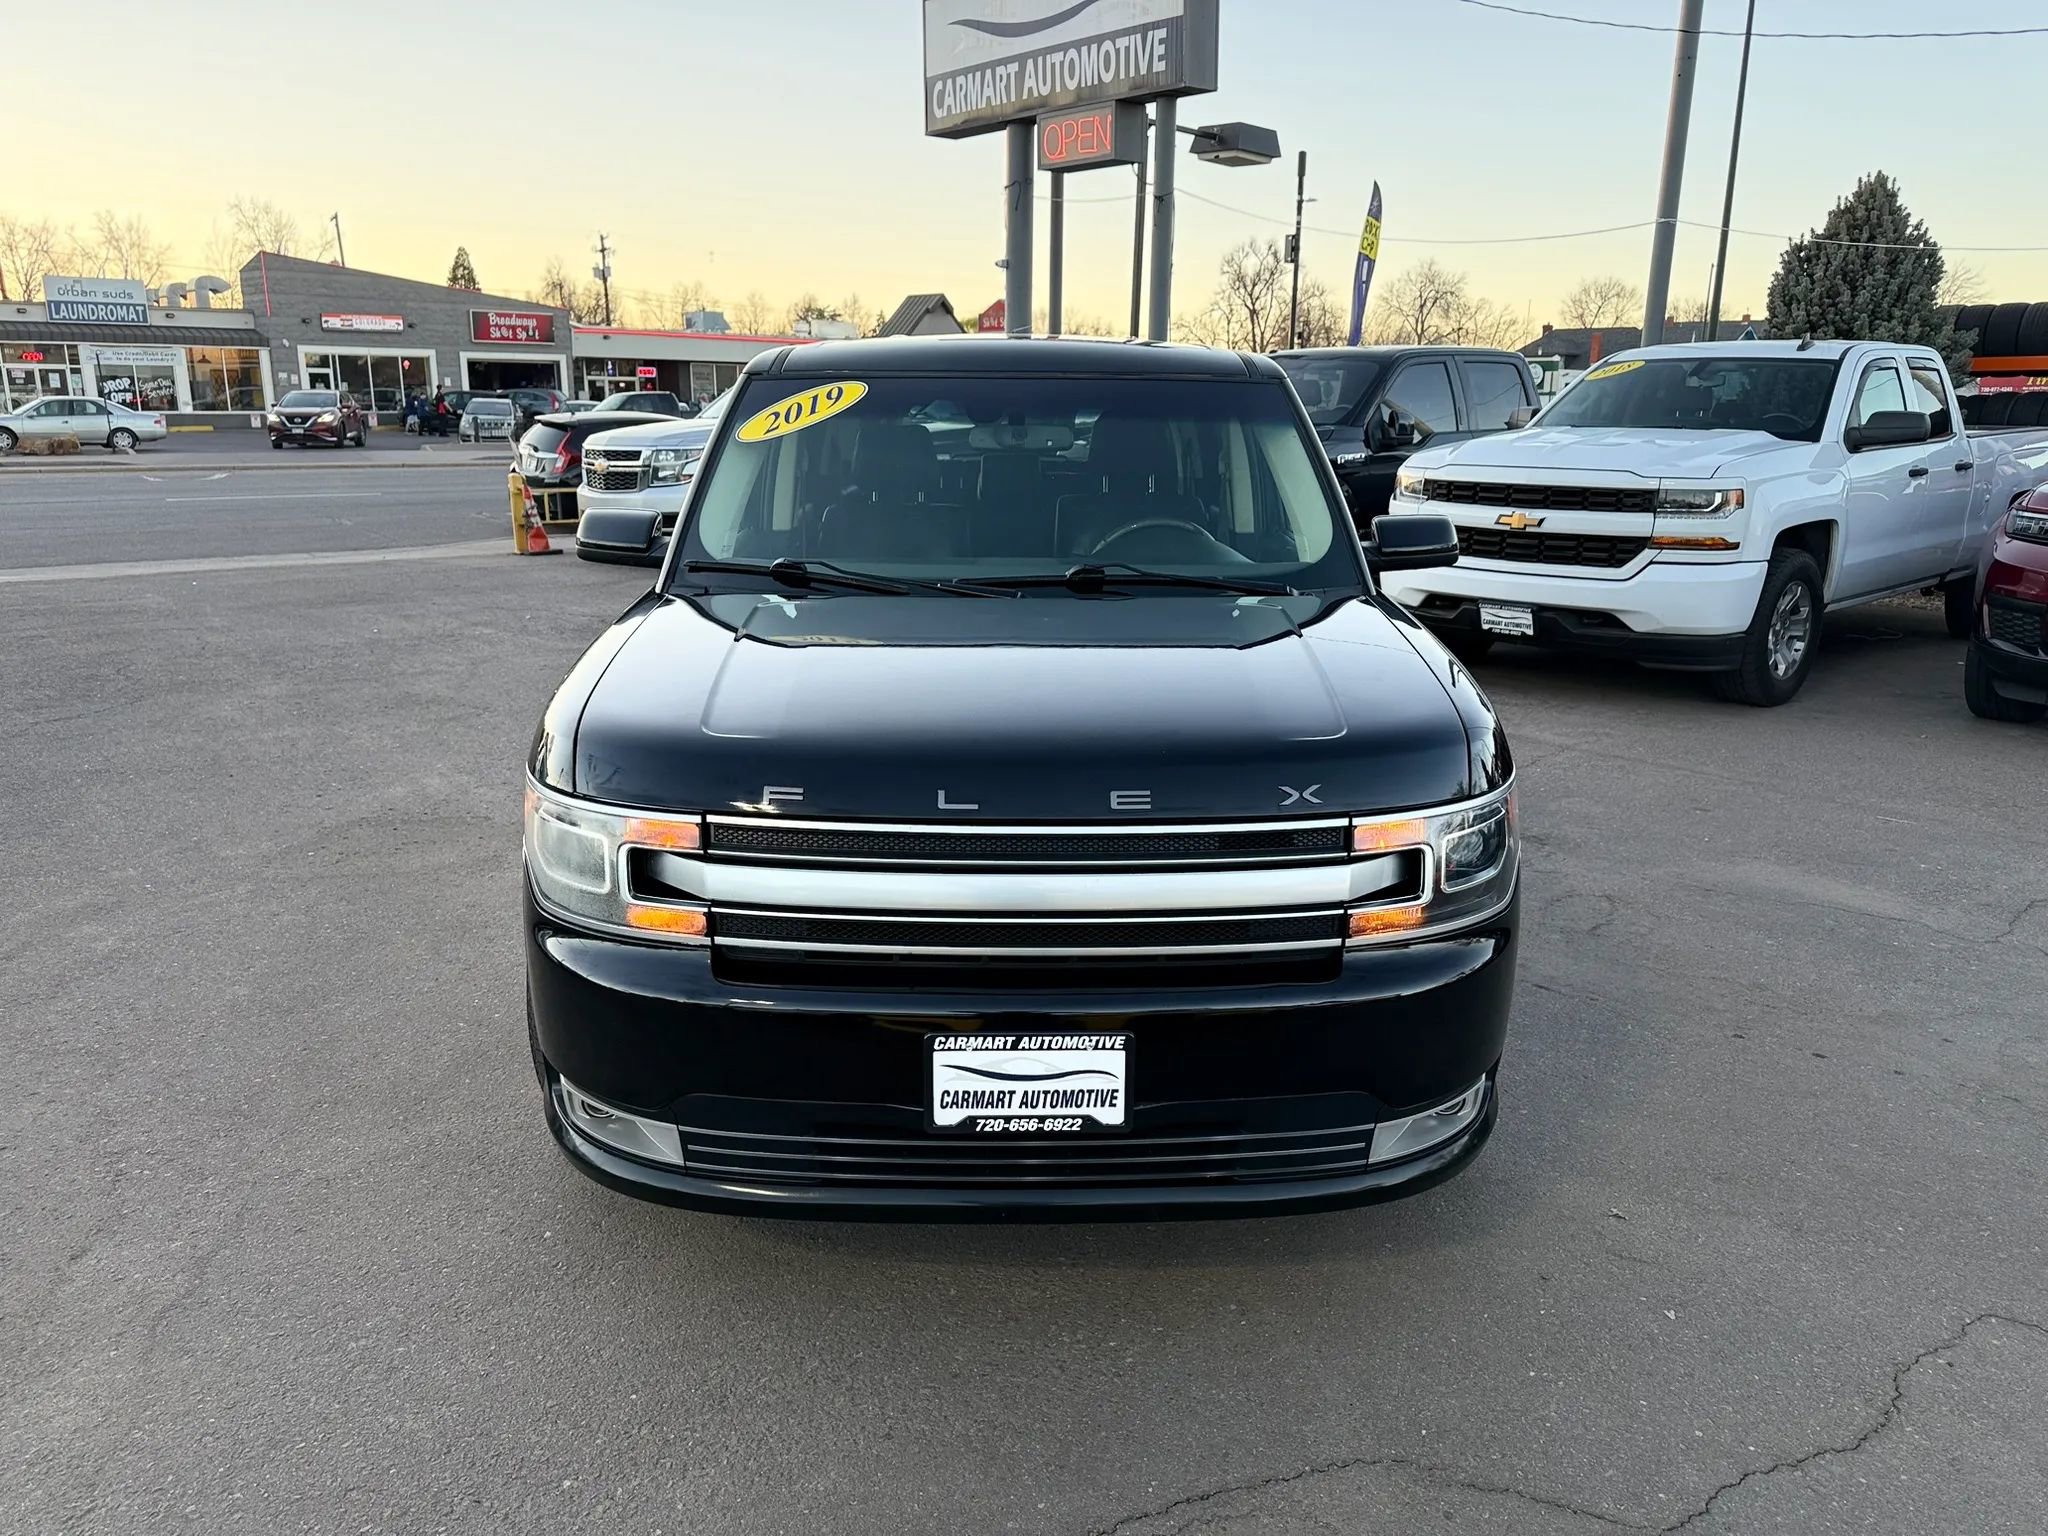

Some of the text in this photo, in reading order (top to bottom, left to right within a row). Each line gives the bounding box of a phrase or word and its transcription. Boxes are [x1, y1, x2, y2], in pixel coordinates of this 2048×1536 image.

[933, 27, 1168, 118] CARMART AUTOMOTIVE
[1043, 113, 1112, 160] OPEN
[102, 289, 134, 299] suds
[51, 303, 144, 322] LAUNDROMAT
[100, 377, 131, 394] DROP
[110, 391, 134, 404] OFF
[763, 386, 844, 435] 2019
[933, 1035, 1127, 1051] CARMART AUTOMOTIVE
[939, 1088, 1120, 1111] CARMART AUTOMOTIVE
[975, 1117, 1083, 1133] 720-656-6922
